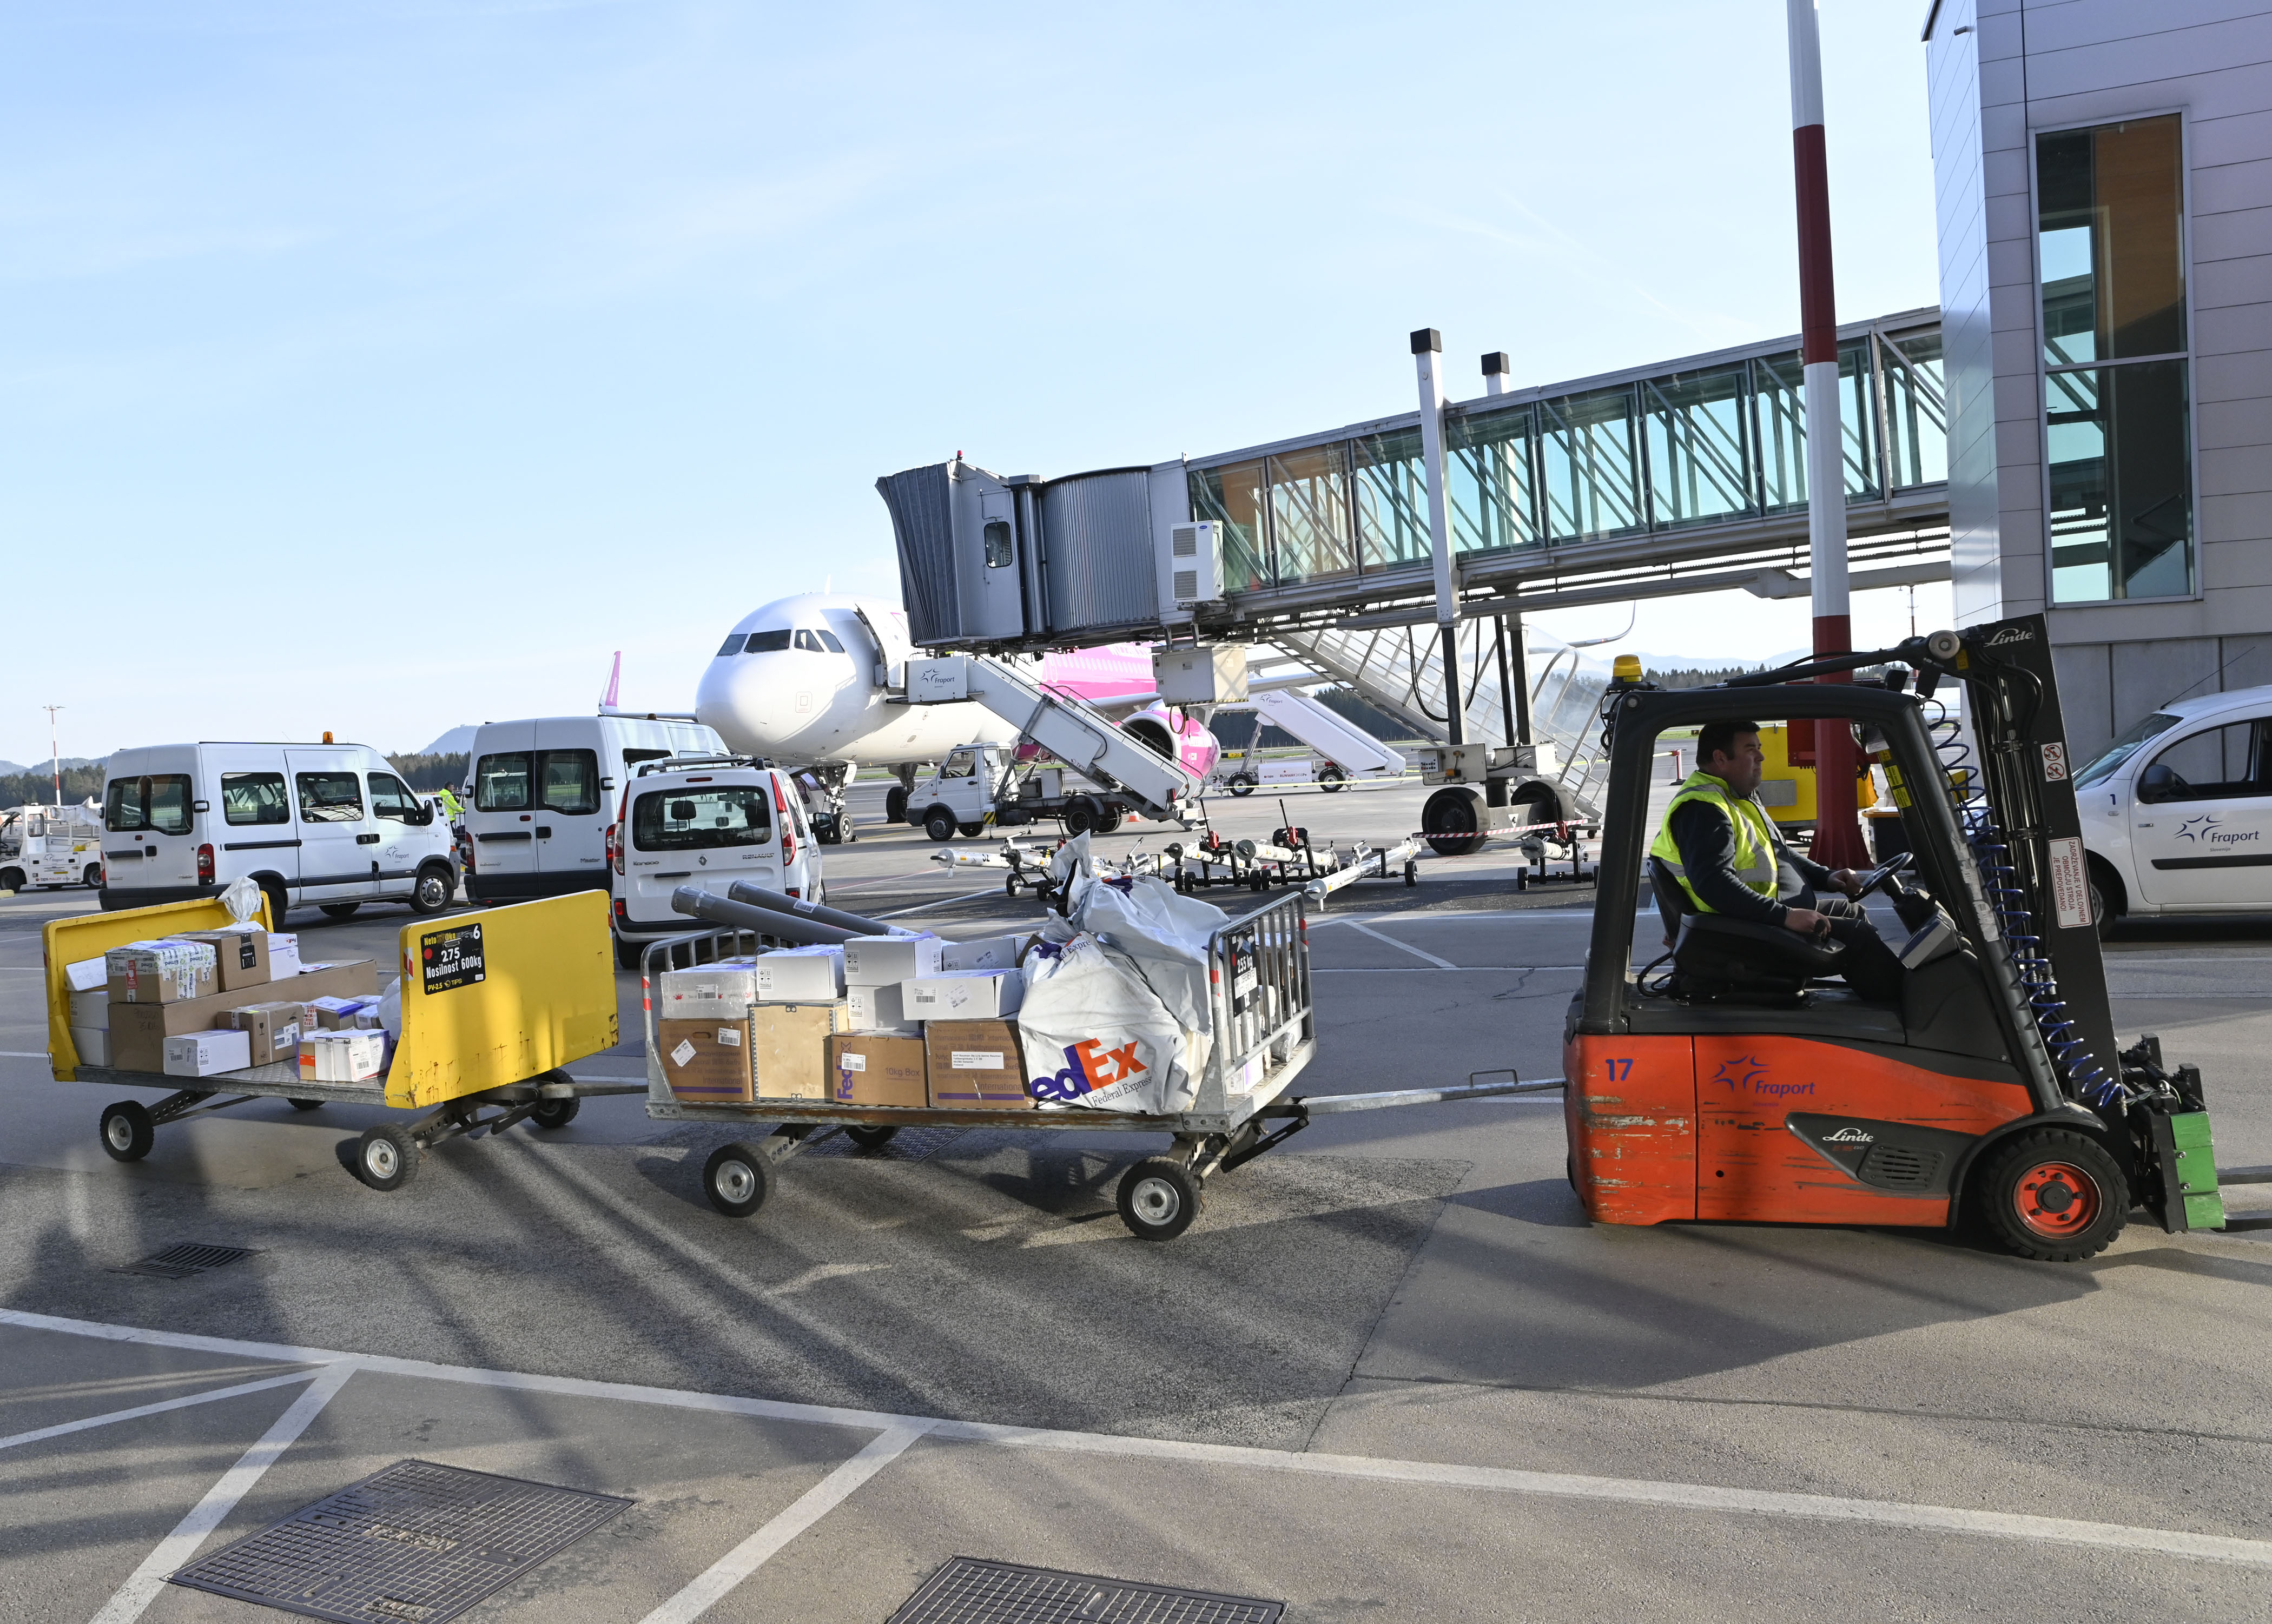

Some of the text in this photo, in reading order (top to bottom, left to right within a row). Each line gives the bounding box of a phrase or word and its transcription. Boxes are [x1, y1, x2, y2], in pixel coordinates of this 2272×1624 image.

[1983, 628, 2033, 647] Linde
[2110, 794, 2116, 805] 1
[2211, 831, 2260, 844] Fraport
[2055, 865, 2067, 912] PREPOVEDANO!
[2062, 856, 2075, 910] OBMOČJU STROJA
[2069, 841, 2081, 883] ZADRŽEVANJE
[2076, 890, 2086, 923] DELOVNEM
[473, 925, 480, 939] 6
[424, 937, 437, 946] Neto
[1066, 940, 1092, 954] Expre
[441, 947, 460, 963] 275
[426, 955, 482, 979] Nosilnost 600kg
[1237, 954, 1253, 974] 255 kg
[427, 982, 443, 992] PV-2.5
[885, 1067, 920, 1077] 10kg Box
[1030, 1038, 1147, 1101] edEx
[1606, 1059, 1633, 1082] 17
[703, 1077, 742, 1085] International
[1092, 1076, 1152, 1106] Federal Express
[1755, 1081, 1815, 1098] Fraport
[1822, 1128, 1874, 1142] Linde
